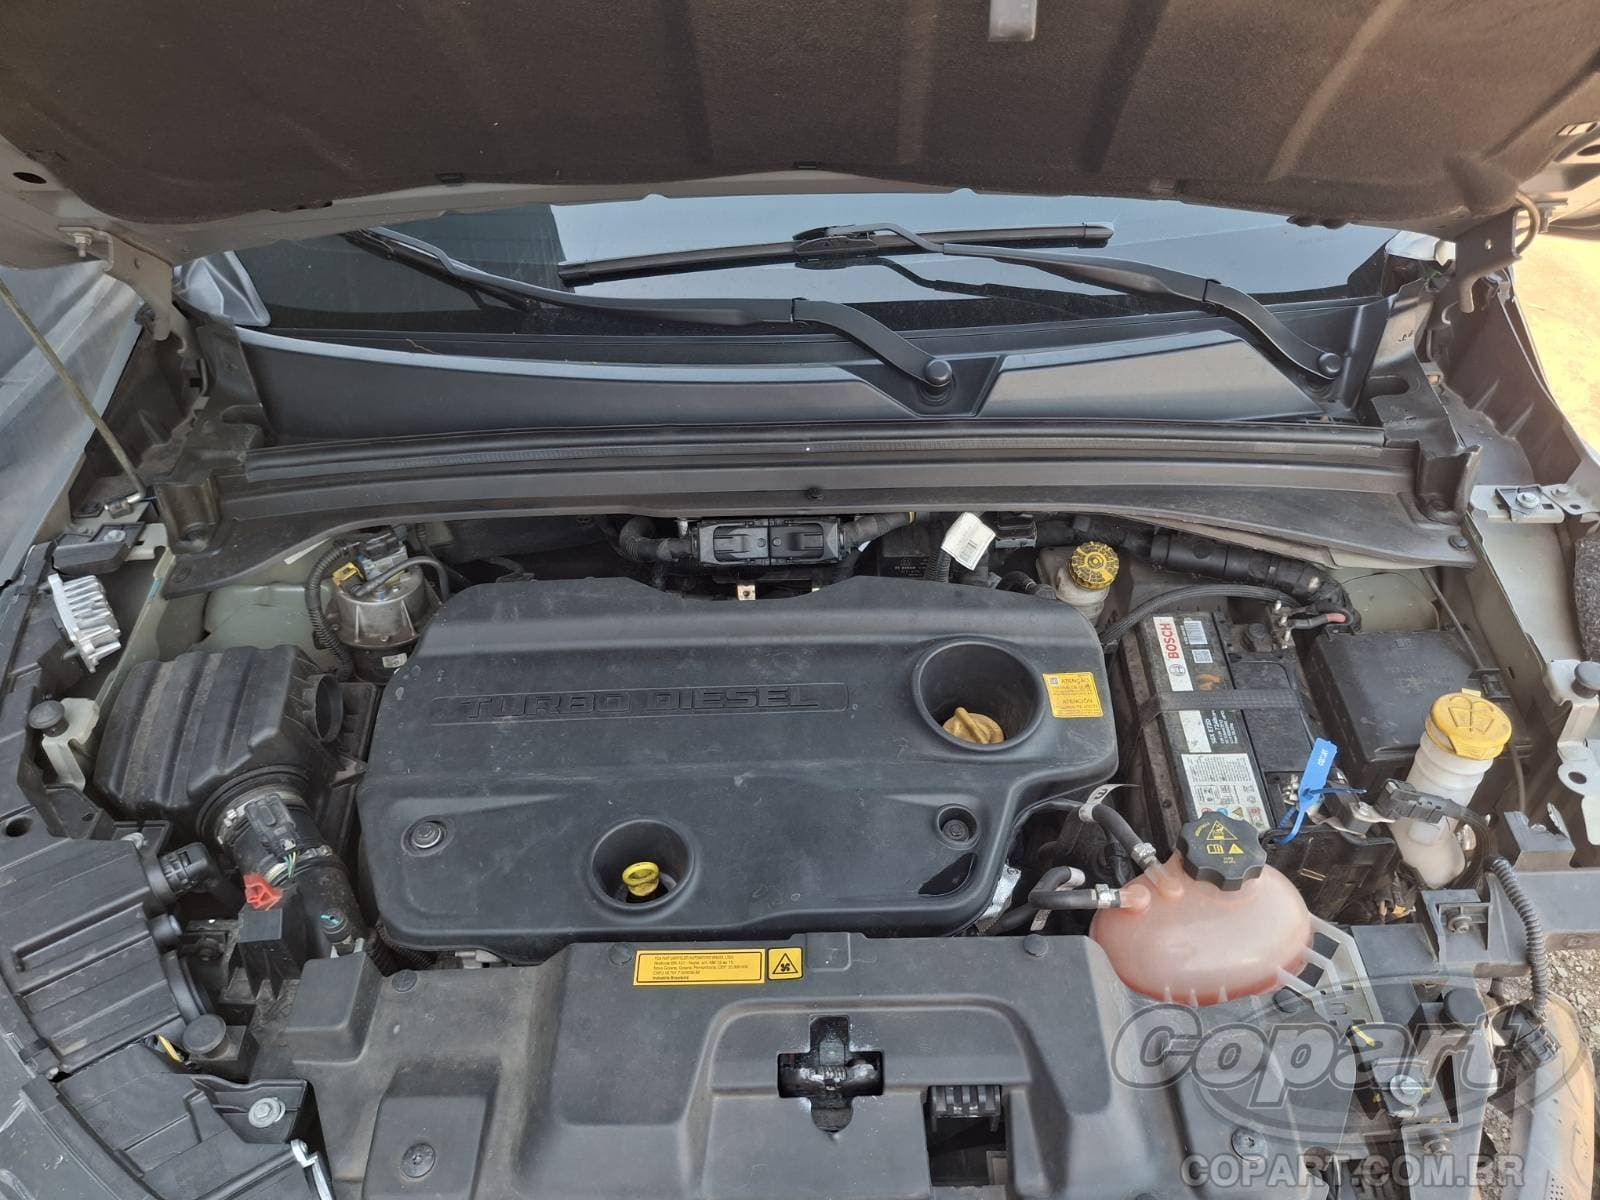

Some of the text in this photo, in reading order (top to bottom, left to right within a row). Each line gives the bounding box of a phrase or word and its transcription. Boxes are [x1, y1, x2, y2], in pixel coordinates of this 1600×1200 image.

[1159, 623, 1180, 659] BOSCH
[460, 686, 819, 718] TURBO DIESEL
